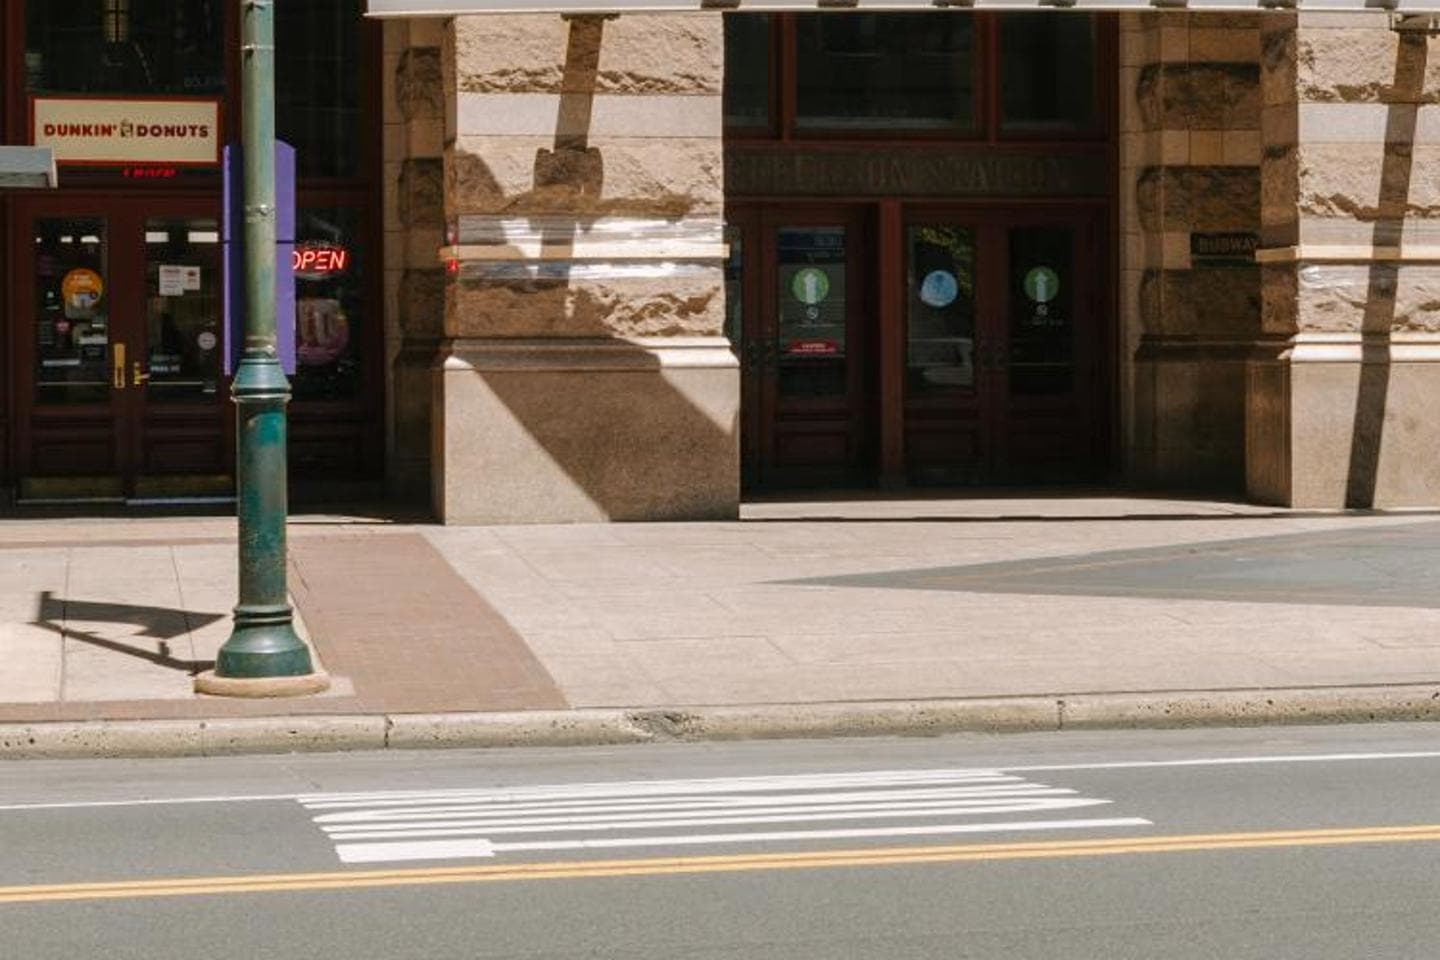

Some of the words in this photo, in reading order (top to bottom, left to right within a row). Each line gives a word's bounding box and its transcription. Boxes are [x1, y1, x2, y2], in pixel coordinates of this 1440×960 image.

[43, 123, 117, 137] DUNKIN'
[136, 123, 209, 138] DONUTS
[292, 250, 346, 271] OPEN
